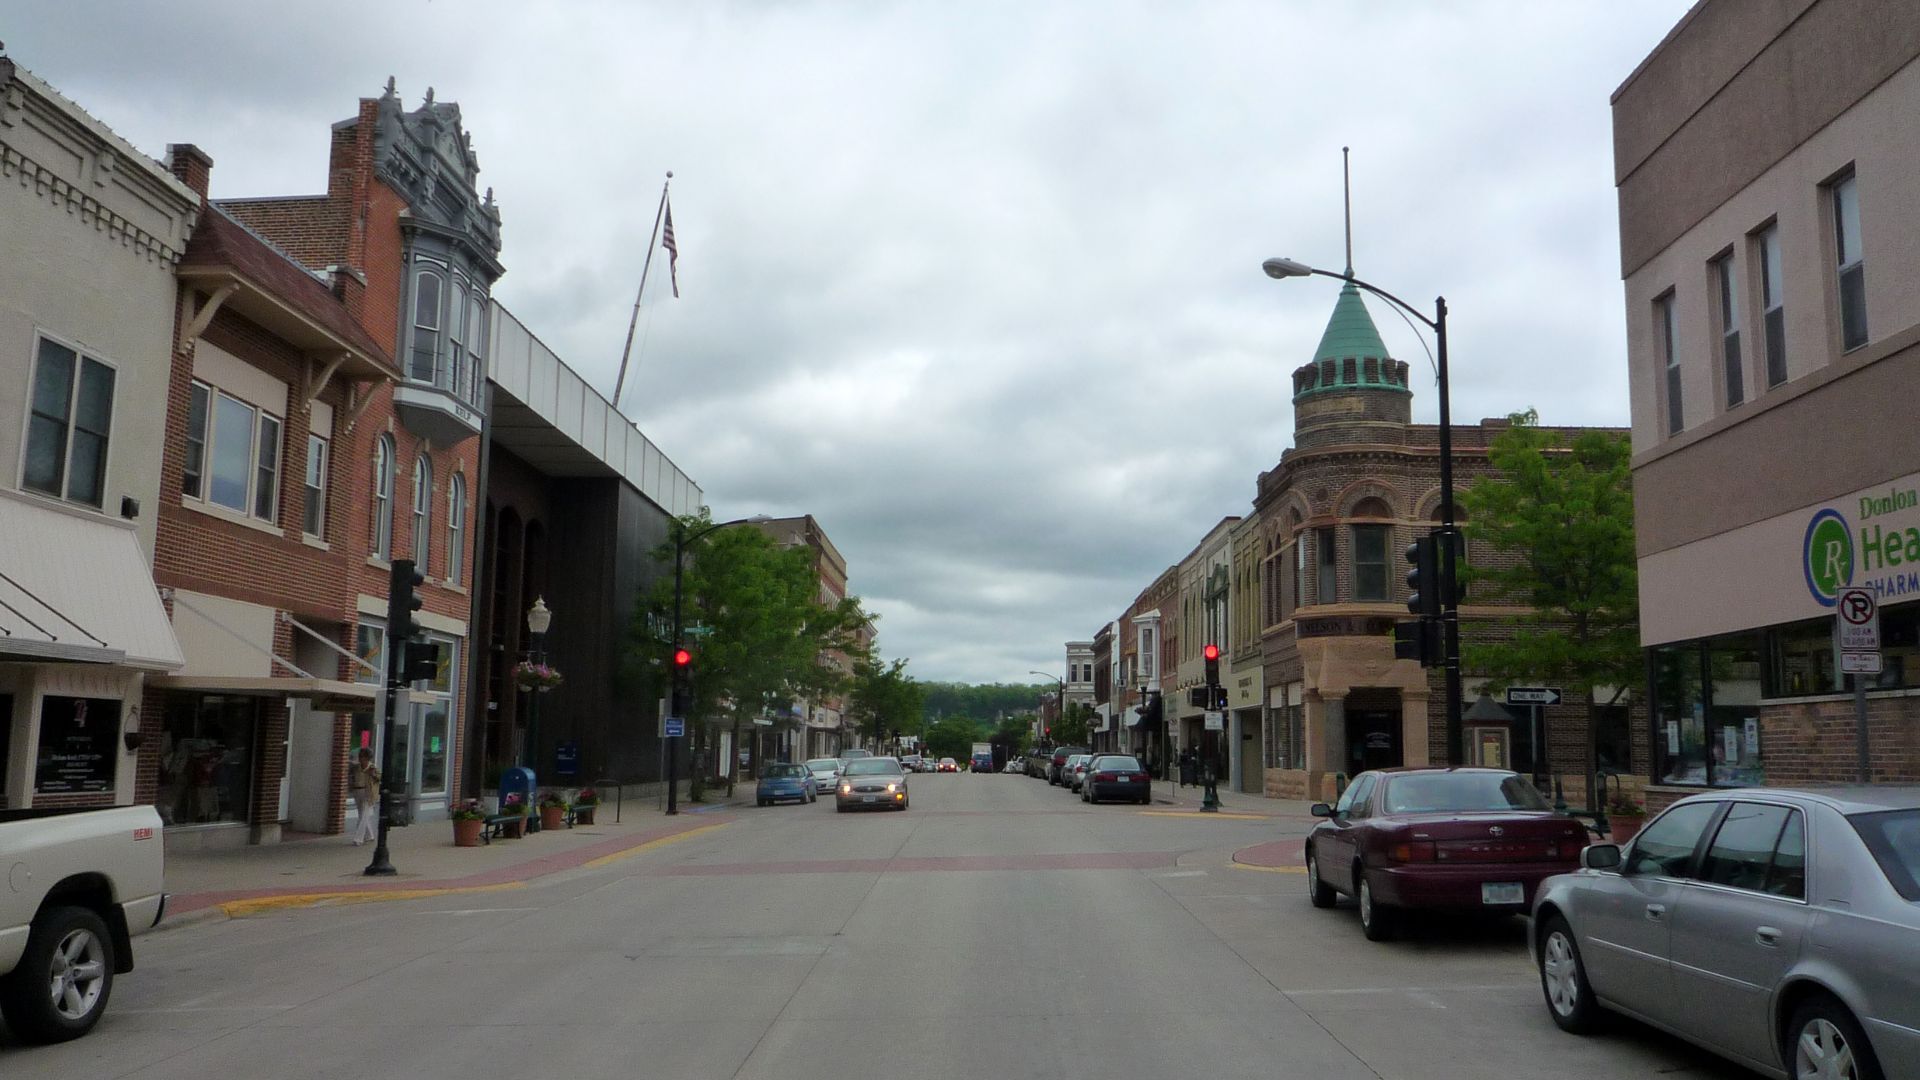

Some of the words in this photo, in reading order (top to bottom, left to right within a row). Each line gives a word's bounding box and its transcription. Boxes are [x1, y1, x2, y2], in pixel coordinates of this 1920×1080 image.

[1861, 489, 1918, 520] Donlon
[1512, 692, 1528, 700] ONE
[1529, 692, 1544, 700] WAY
[134, 827, 153, 839] HEMI
